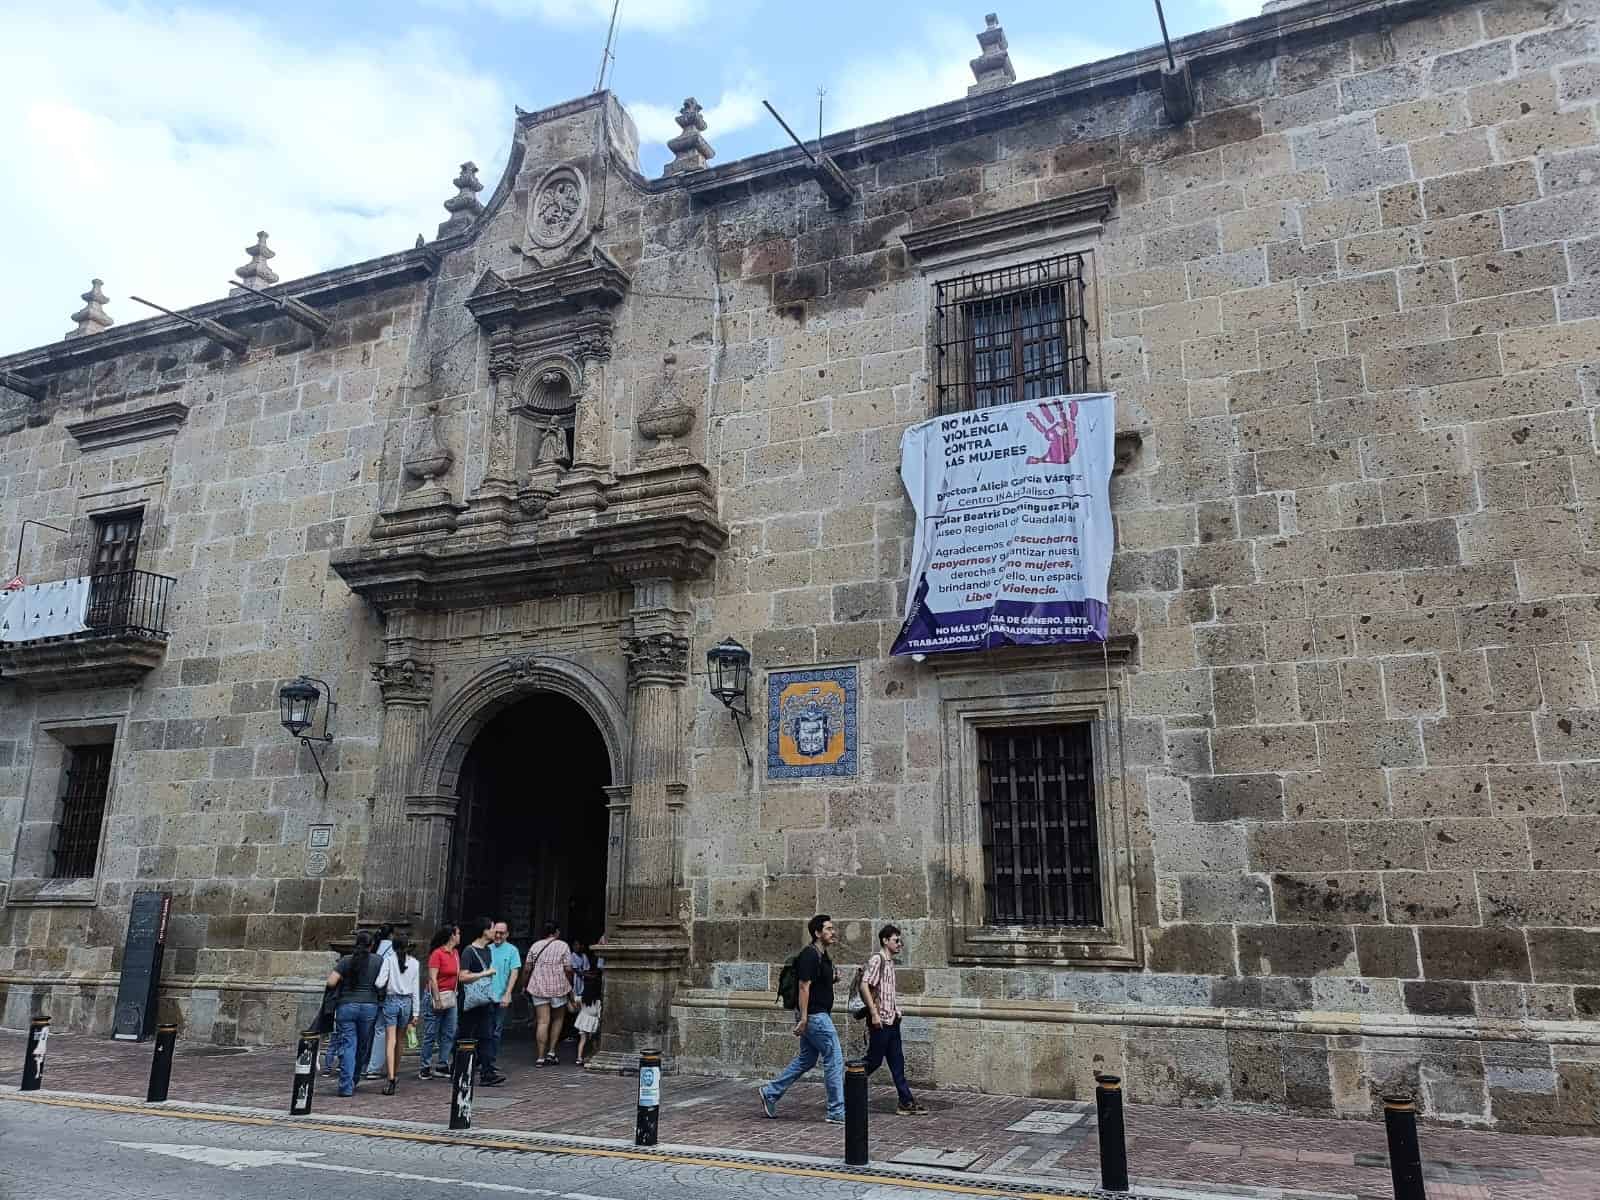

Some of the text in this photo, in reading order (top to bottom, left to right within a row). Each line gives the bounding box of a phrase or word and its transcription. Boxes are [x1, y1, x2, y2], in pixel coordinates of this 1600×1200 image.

[942, 419, 958, 432] NO
[943, 422, 1008, 443] VIOLENCIA
[945, 438, 992, 456] CONTRA
[946, 445, 1027, 469] LAS MUJERES
[980, 480, 1008, 491] Alicia
[1011, 475, 1042, 487] García
[958, 495, 993, 507] Centro
[964, 507, 1001, 522] Beatriz
[936, 527, 962, 539] useo
[965, 518, 1008, 534] Regional
[1021, 513, 1076, 525] Guadalaja
[936, 541, 1003, 557] Agradecemos
[931, 546, 1079, 571] apoyarnos y gantizar nuest
[1030, 574, 1045, 582] un
[965, 592, 993, 603] Libre
[935, 627, 949, 635] NO
[1007, 616, 1020, 625] DE
[1064, 616, 1089, 625] ENT
[908, 634, 980, 648] TRABAJADORAS
[988, 624, 1049, 635] ABAJADORES
[1050, 626, 1063, 635] DE
